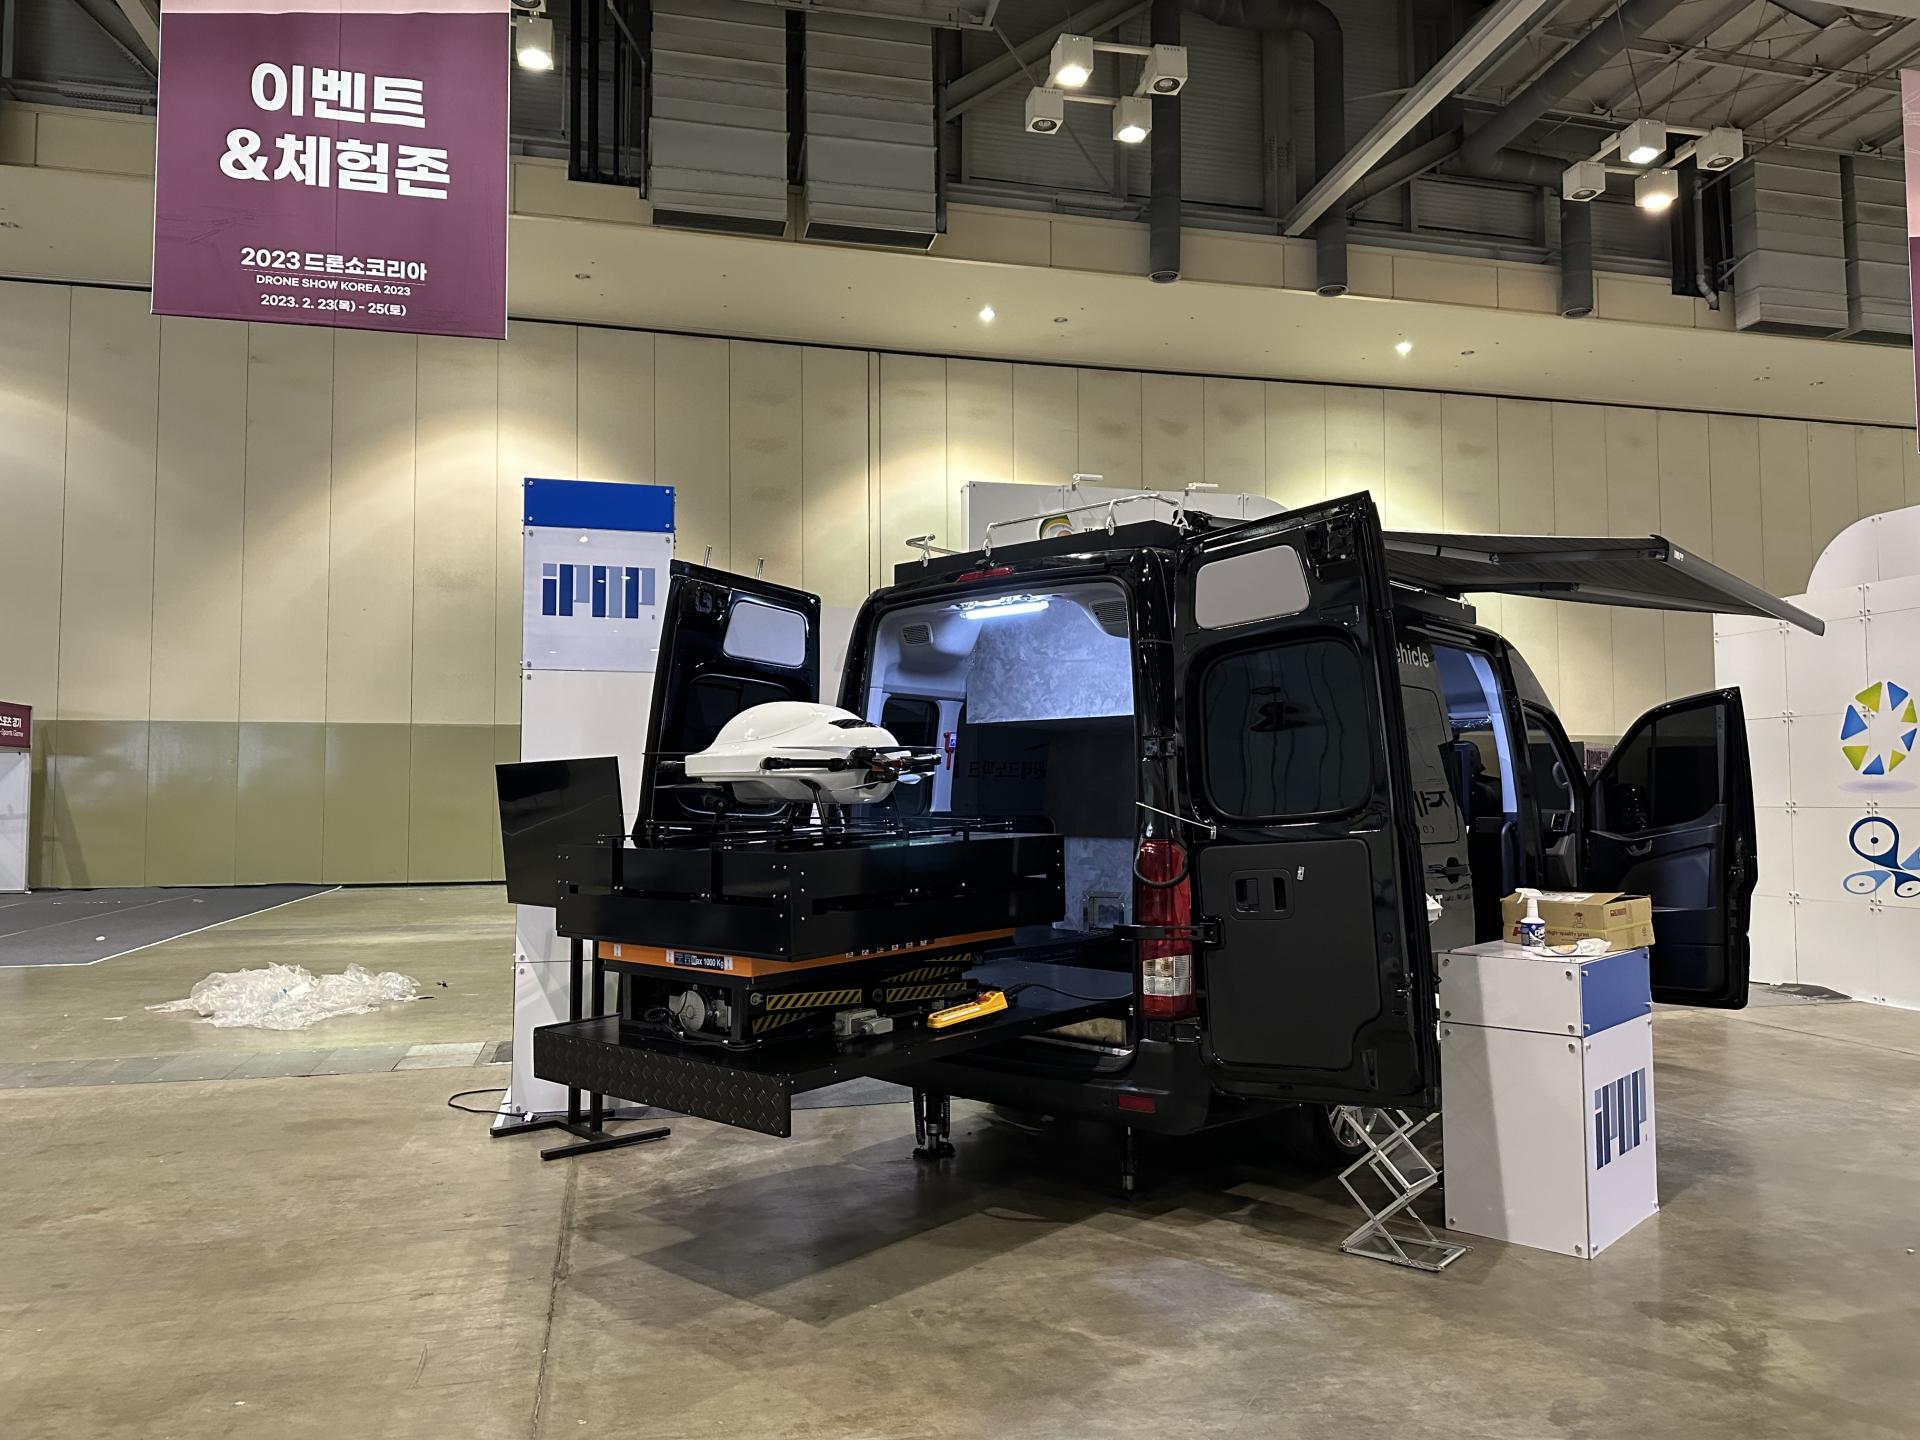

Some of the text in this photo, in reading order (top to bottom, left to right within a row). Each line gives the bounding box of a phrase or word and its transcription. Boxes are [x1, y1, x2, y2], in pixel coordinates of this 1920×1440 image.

[251, 62, 426, 128] 이벤트
[219, 128, 450, 200] &체험존
[256, 274, 411, 296] DRONE SHOW KOREA 2023
[260, 293, 299, 308] 2023.
[302, 297, 315, 309] 2.
[317, 298, 356, 313] 23(목)
[367, 302, 407, 317] 25(토)
[703, 957, 716, 967] 1000
